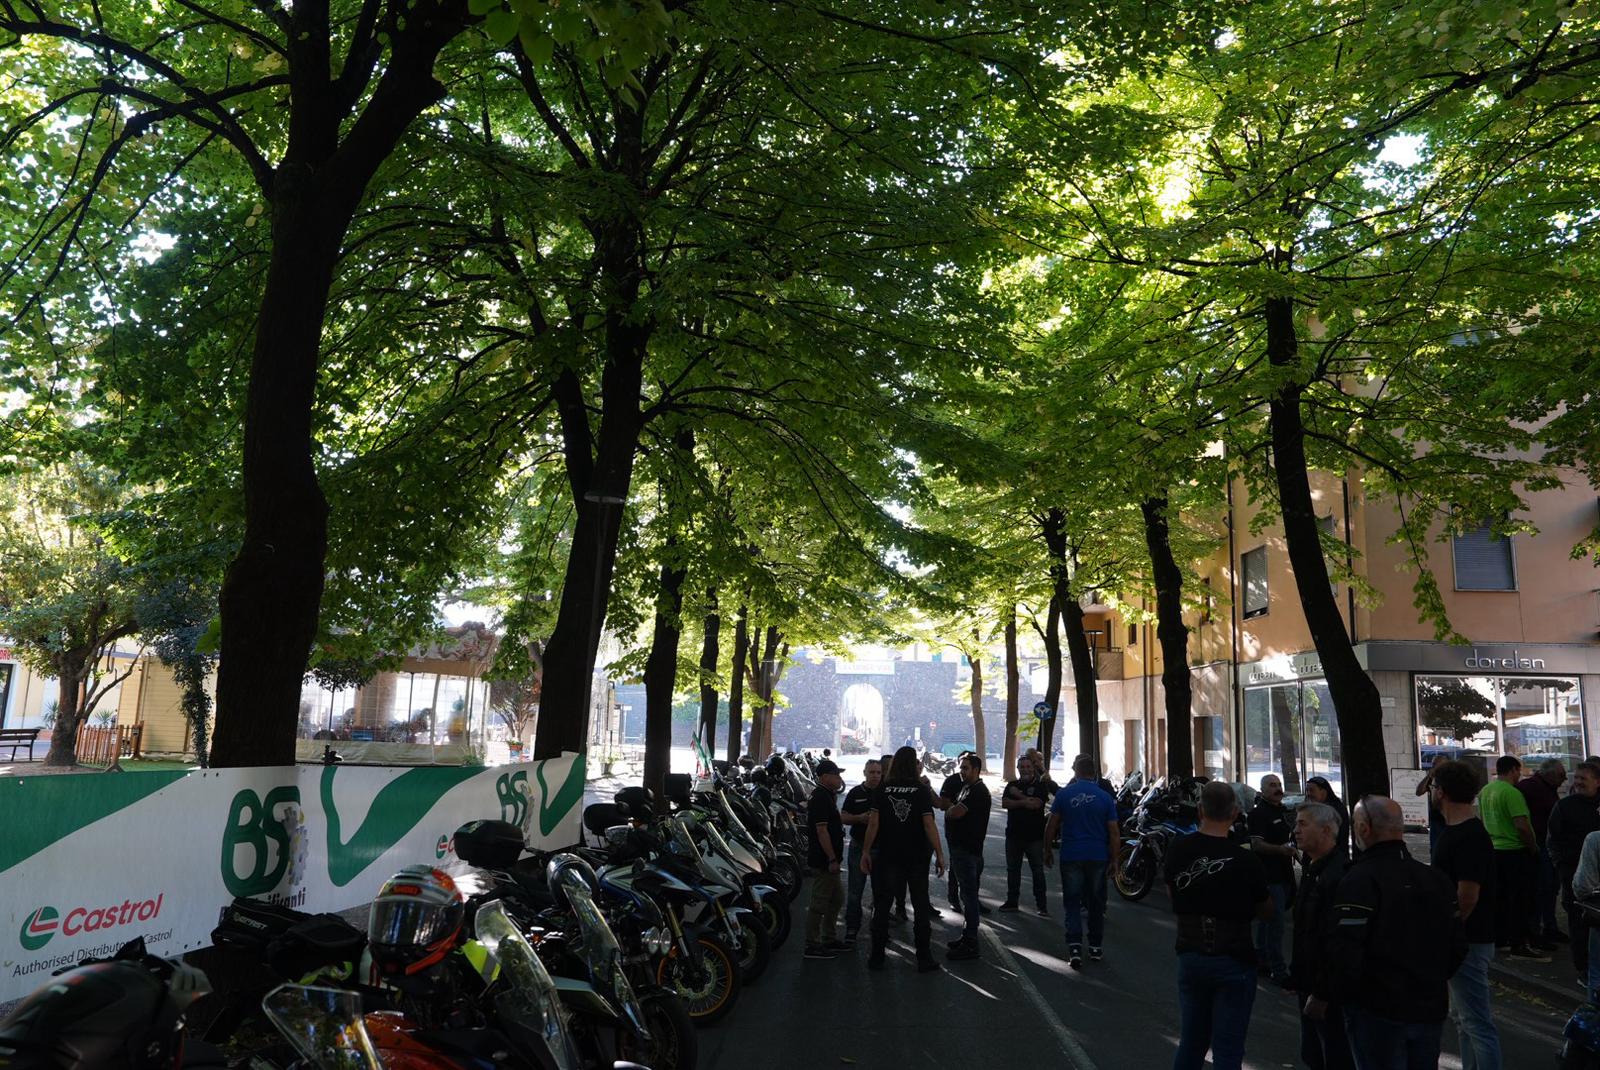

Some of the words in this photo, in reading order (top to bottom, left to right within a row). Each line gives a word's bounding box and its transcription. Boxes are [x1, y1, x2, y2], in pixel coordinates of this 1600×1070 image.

[1465, 649, 1545, 669] dorelan
[1525, 728, 1562, 737] FUORI
[62, 893, 164, 937] Castrol
[12, 951, 74, 977] Authorised
[76, 942, 127, 962] Distributo
